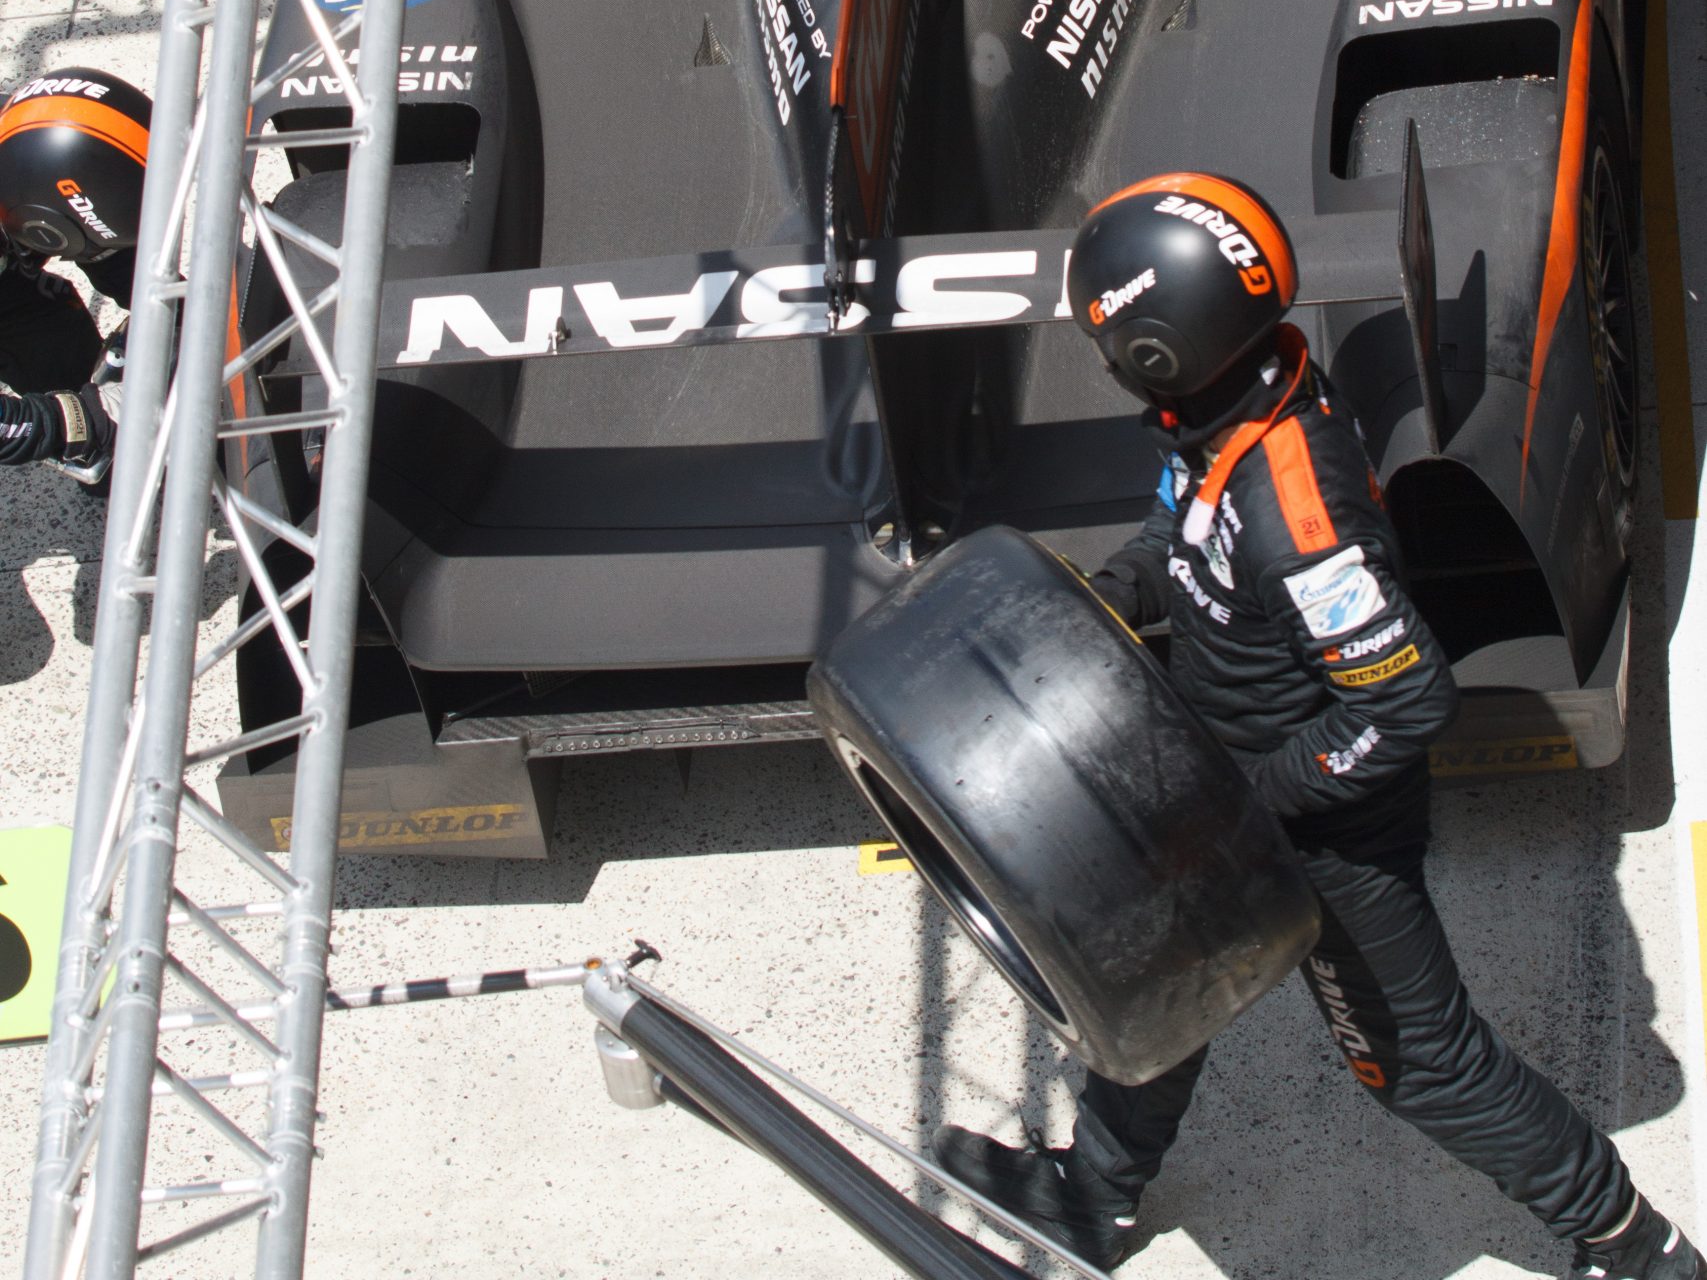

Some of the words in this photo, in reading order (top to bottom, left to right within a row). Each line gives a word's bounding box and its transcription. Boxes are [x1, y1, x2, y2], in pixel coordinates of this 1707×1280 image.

[811, 28, 832, 59] BY
[281, 71, 474, 98] NISAN
[397, 248, 1074, 364] SSAN
[1345, 648, 1415, 684] DUNLOP
